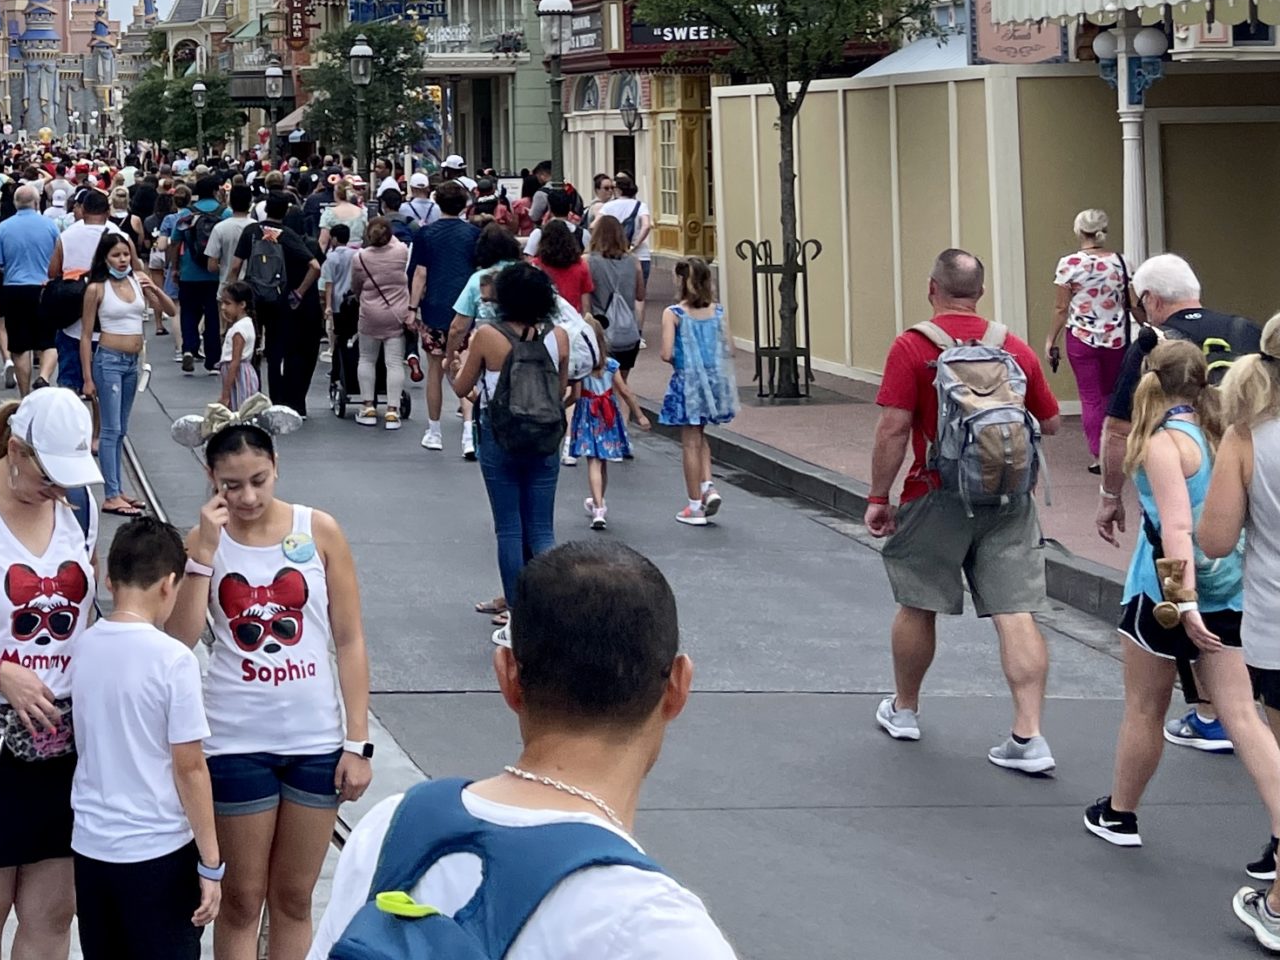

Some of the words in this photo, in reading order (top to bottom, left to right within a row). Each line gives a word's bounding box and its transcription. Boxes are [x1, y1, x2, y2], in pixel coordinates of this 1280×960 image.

[292, 12, 302, 38] ARTS
[1, 648, 72, 674] Mommy
[241, 658, 316, 686] Sophia
